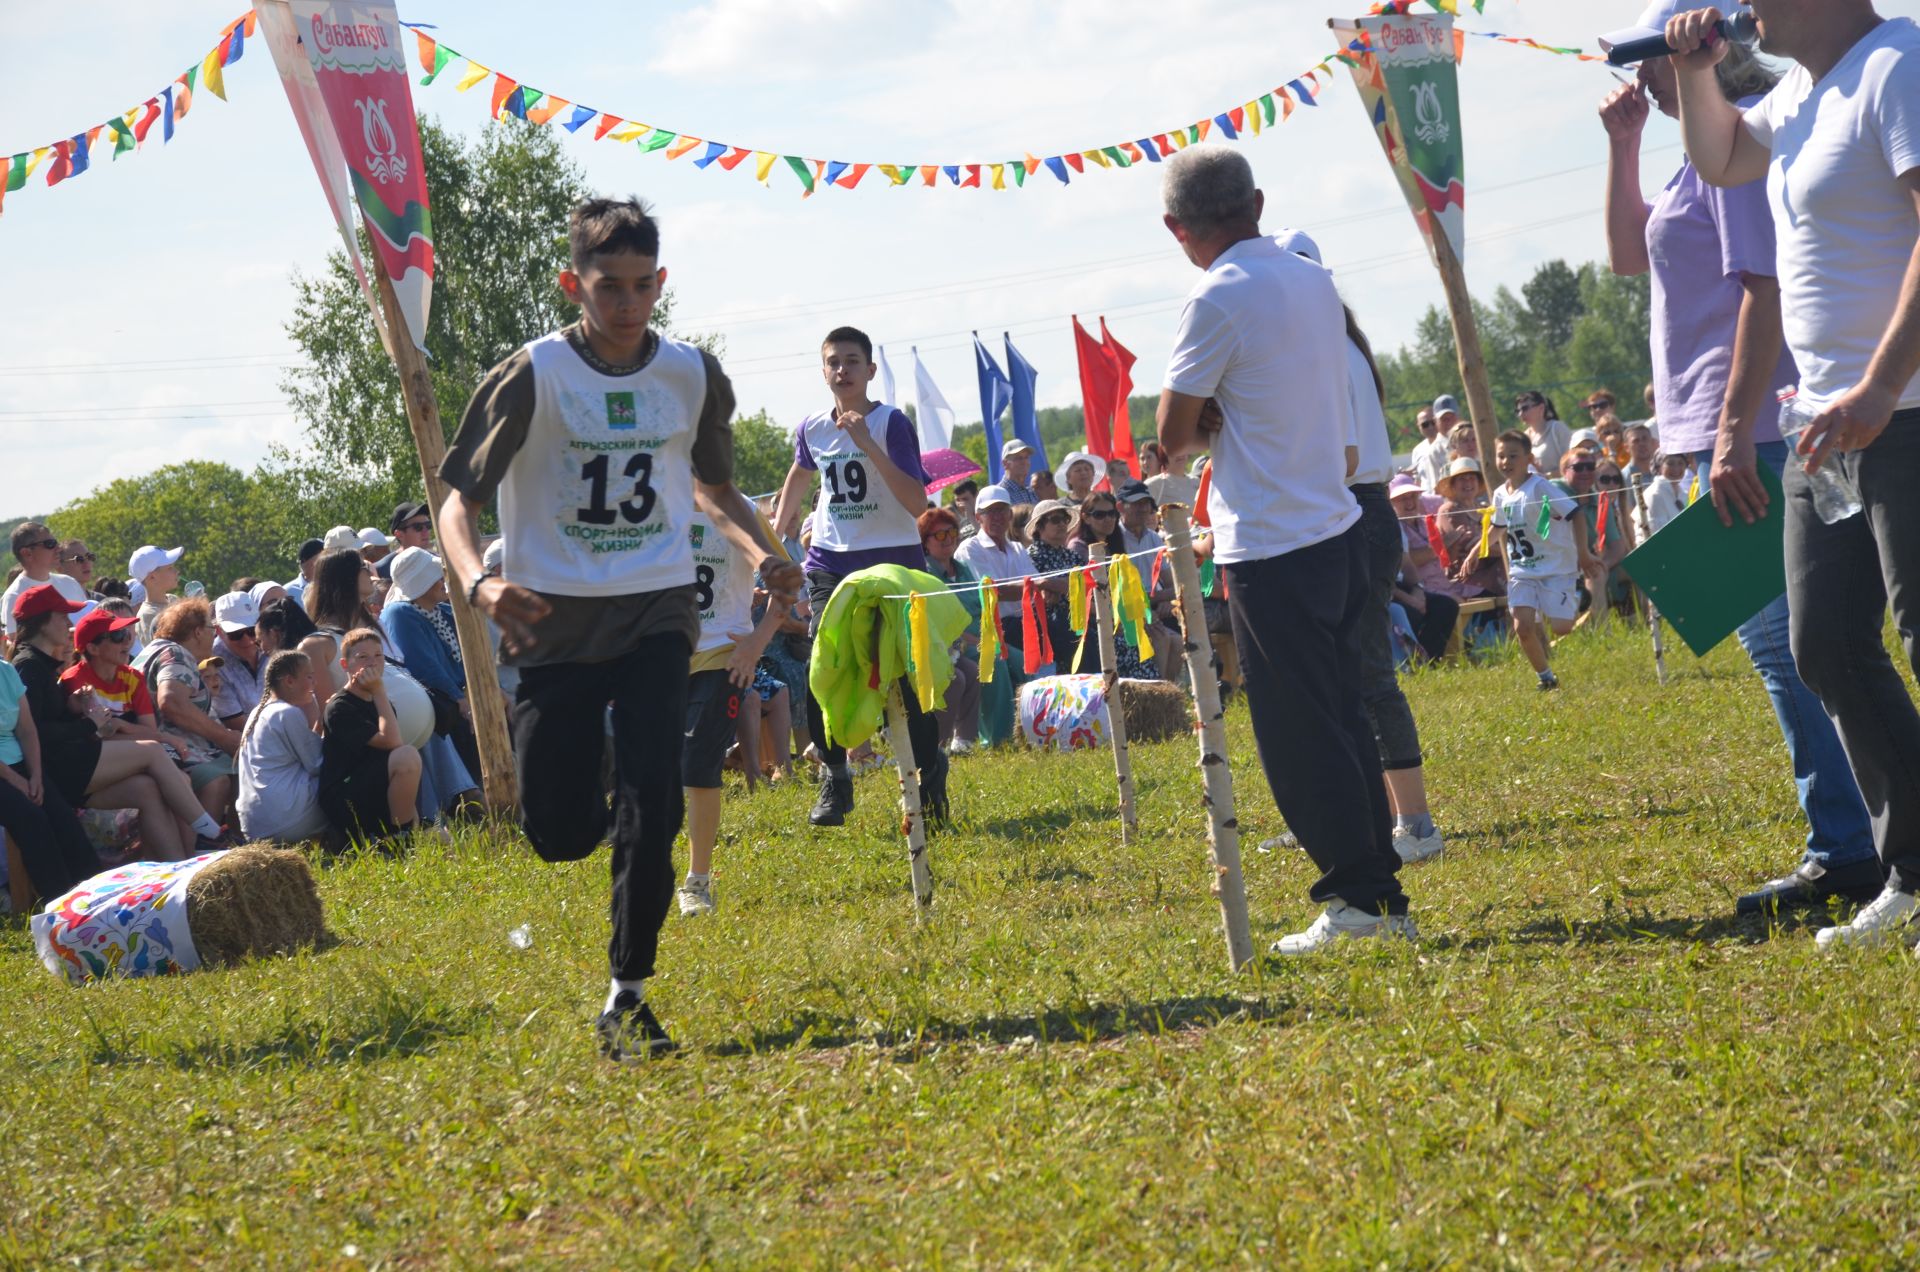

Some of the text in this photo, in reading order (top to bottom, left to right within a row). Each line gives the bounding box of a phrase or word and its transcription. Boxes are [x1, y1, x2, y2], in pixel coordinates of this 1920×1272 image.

[311, 12, 389, 54] Сабантуй
[1381, 22, 1423, 53] Сабан
[569, 437, 667, 451] АГРЫЗСКИЙ РАЙ
[577, 453, 657, 525] 13
[825, 460, 867, 504] 19
[837, 512, 864, 521] ЖИЗНИ
[591, 539, 642, 554] ЖИЗНИ
